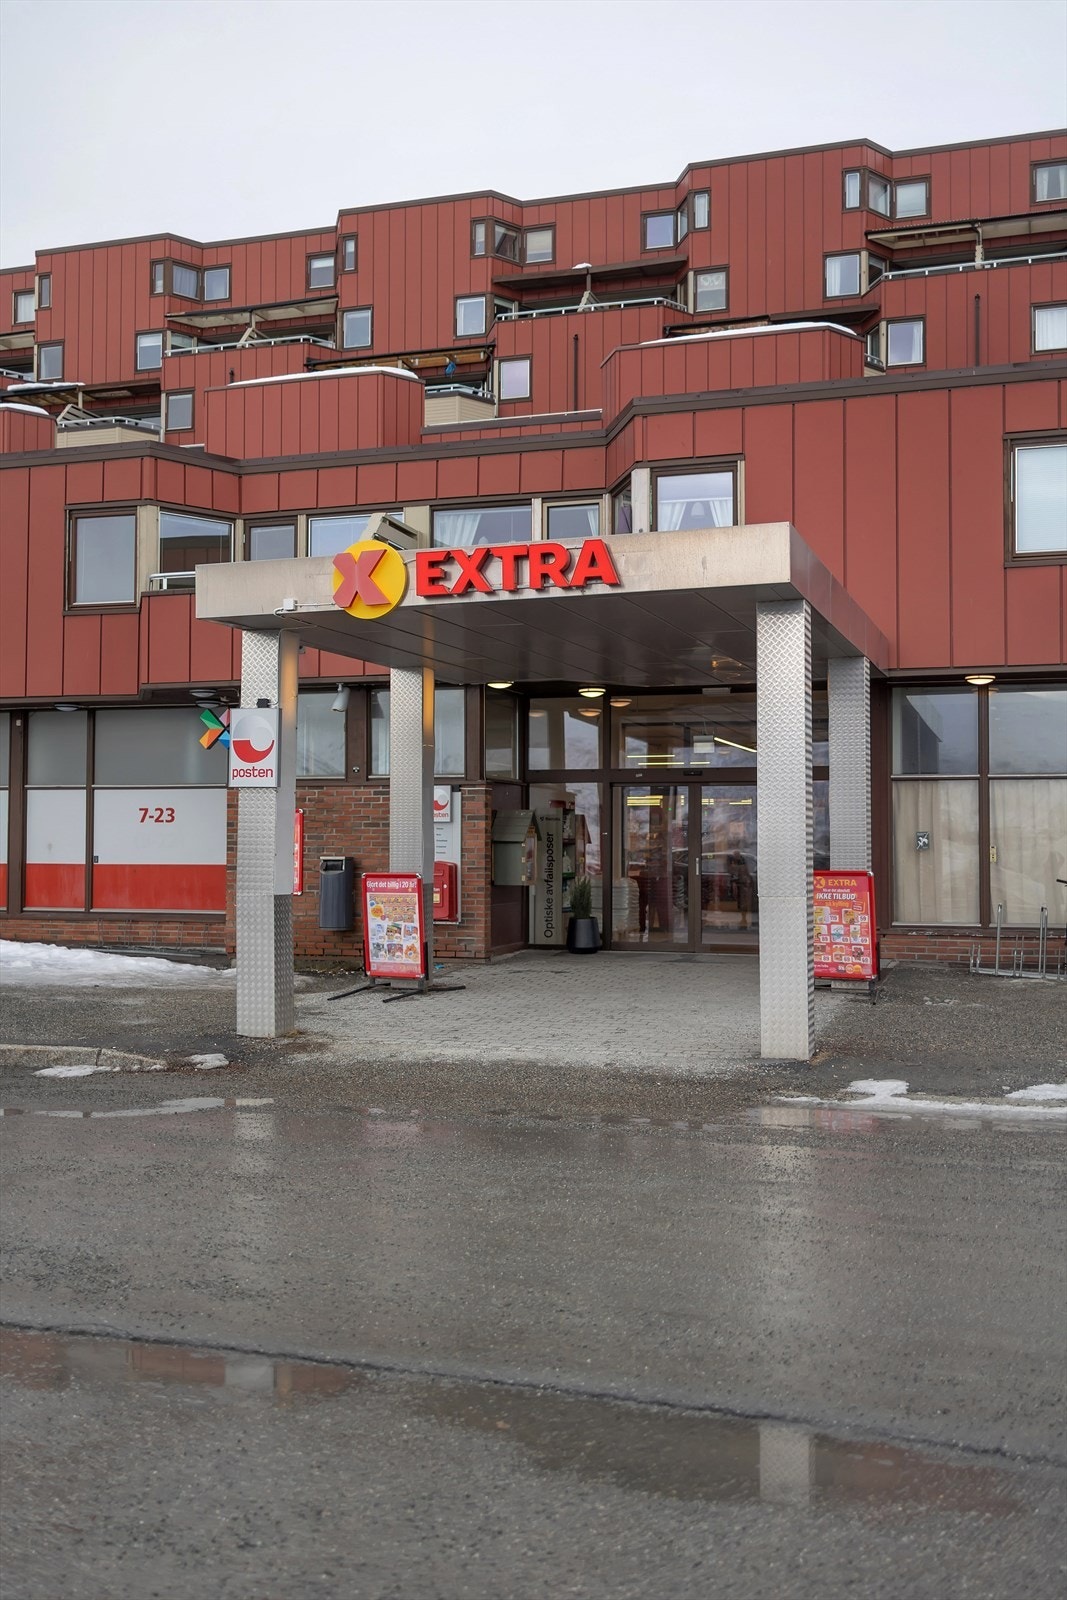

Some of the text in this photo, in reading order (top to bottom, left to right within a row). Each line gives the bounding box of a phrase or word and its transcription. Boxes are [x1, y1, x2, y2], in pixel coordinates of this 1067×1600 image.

[416, 539, 619, 596] EXTRA
[232, 766, 273, 780] posten
[138, 807, 175, 823] 7-23
[828, 879, 857, 887] EXTRA
[816, 892, 856, 900] IKKE TILBUD
[544, 898, 555, 938] Optiske
